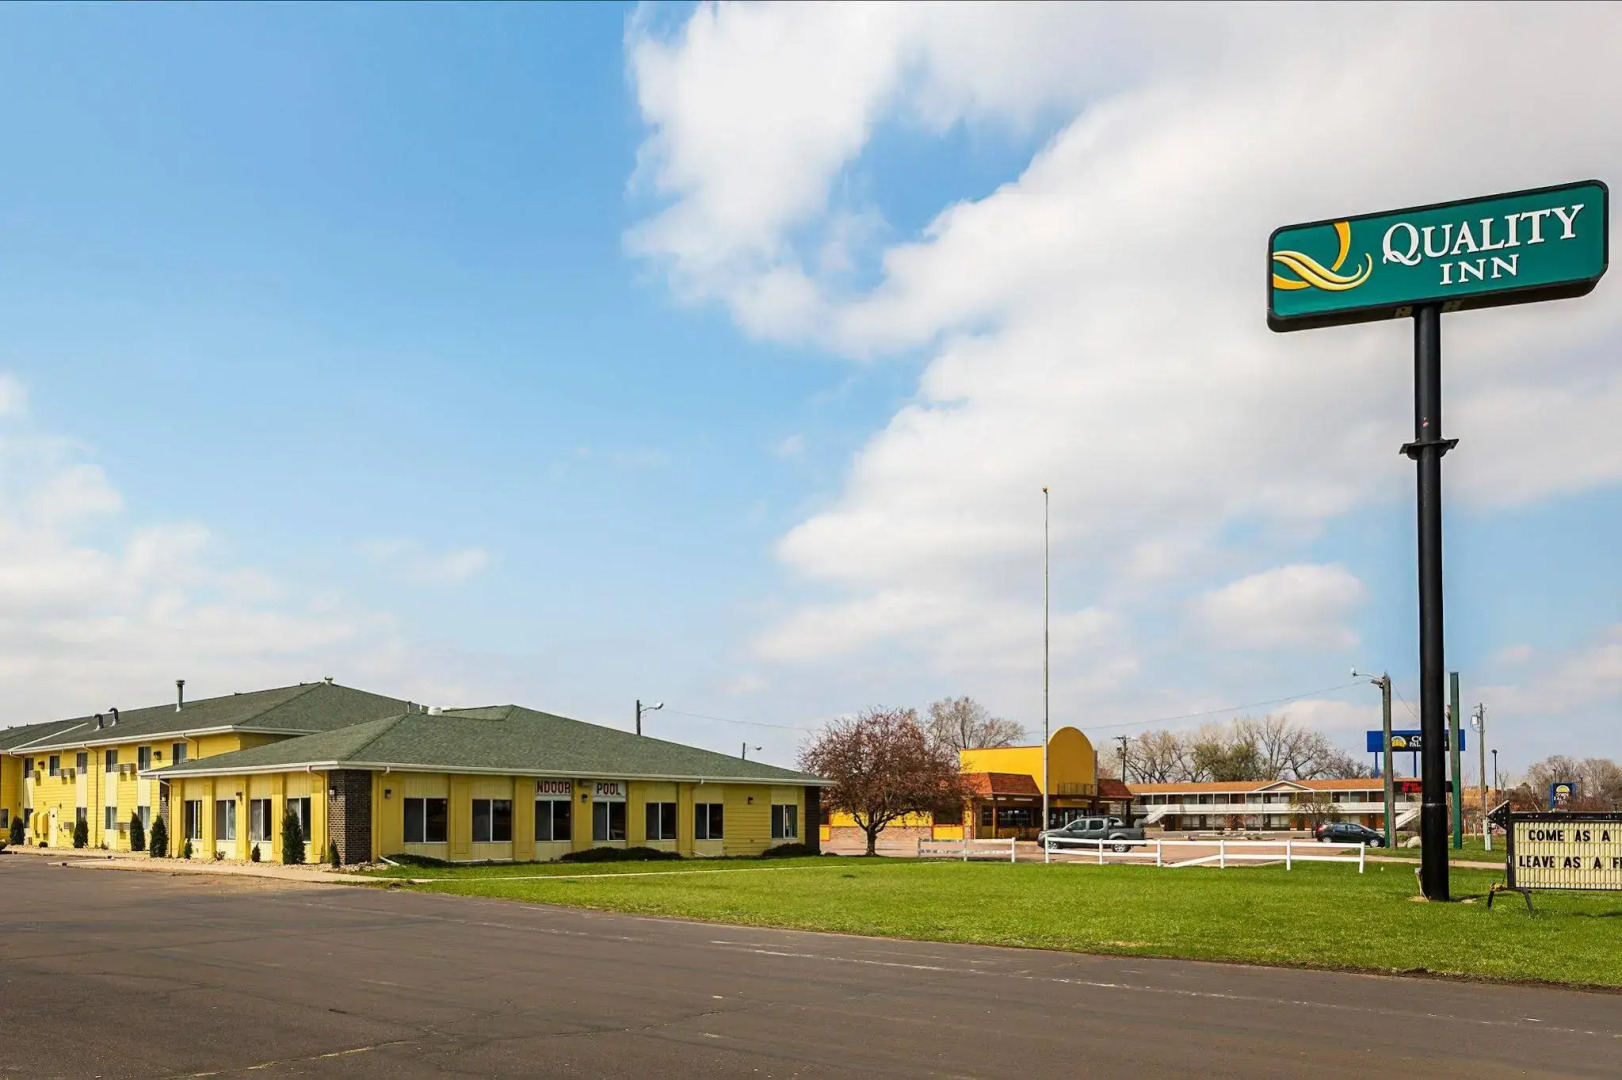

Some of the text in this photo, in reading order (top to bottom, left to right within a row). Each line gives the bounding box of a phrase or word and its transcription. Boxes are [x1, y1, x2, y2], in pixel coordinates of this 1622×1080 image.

[1382, 203, 1585, 266] QUALITY
[1439, 253, 1520, 286] INN
[596, 782, 621, 796] POOL
[1528, 829, 1611, 842] COME AS A
[1519, 855, 1555, 869] LEAVE
[1563, 856, 1581, 869] AS
[1593, 856, 1603, 870] A
